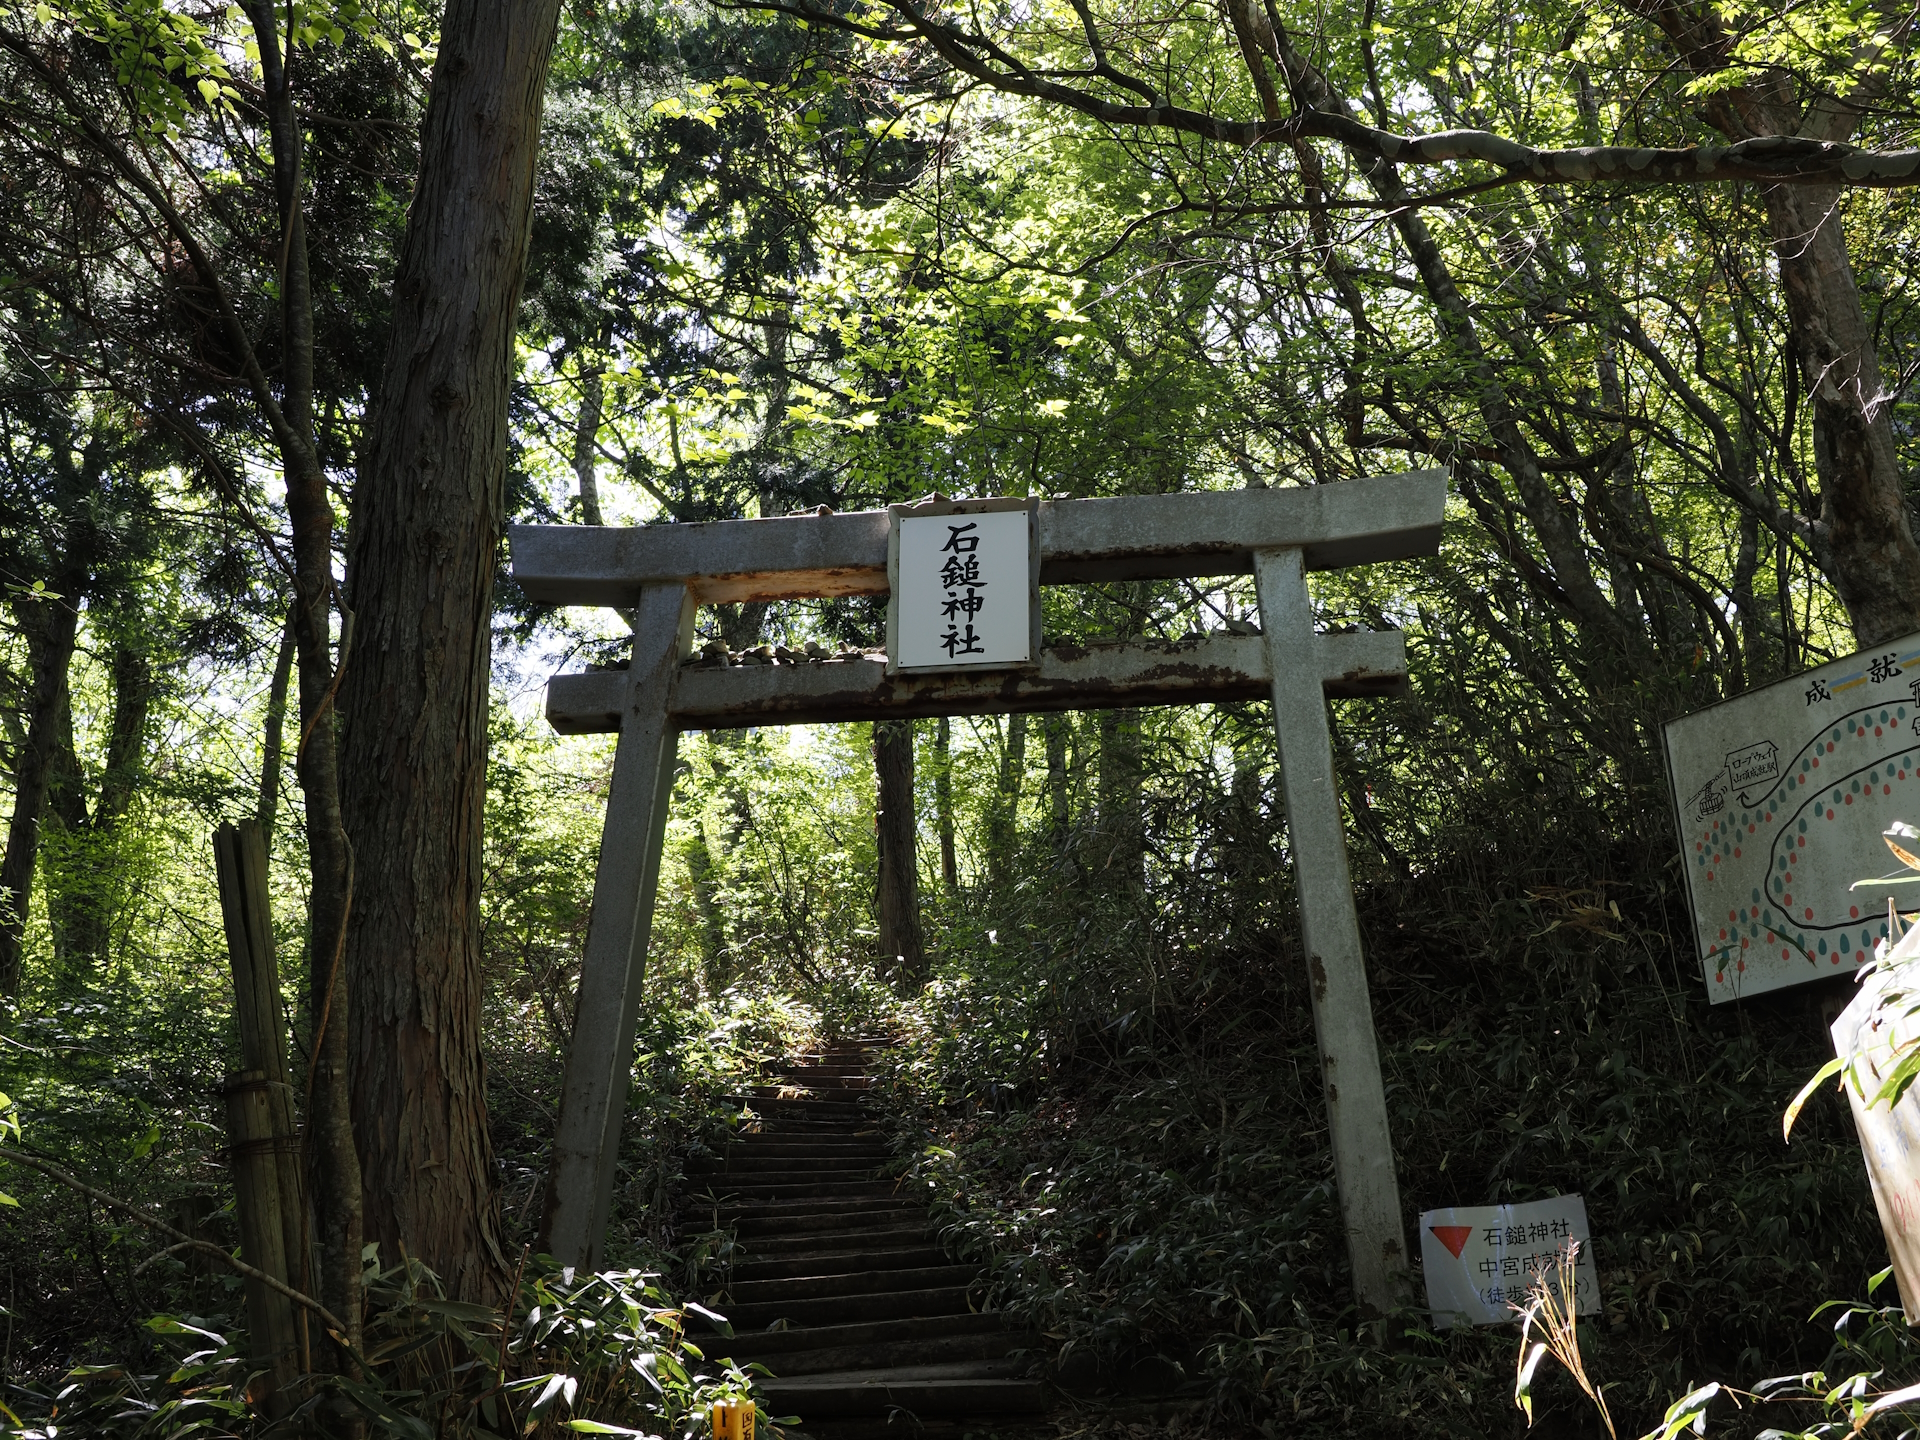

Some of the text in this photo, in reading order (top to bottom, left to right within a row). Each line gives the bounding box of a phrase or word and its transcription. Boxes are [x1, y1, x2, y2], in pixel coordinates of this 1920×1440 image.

[938, 522, 988, 659] 石鎚神社
[1732, 747, 1772, 769] ロープウェイ
[1482, 1218, 1570, 1247] 石鎚神社
[1479, 1276, 1590, 1306] （徒歩3分）
